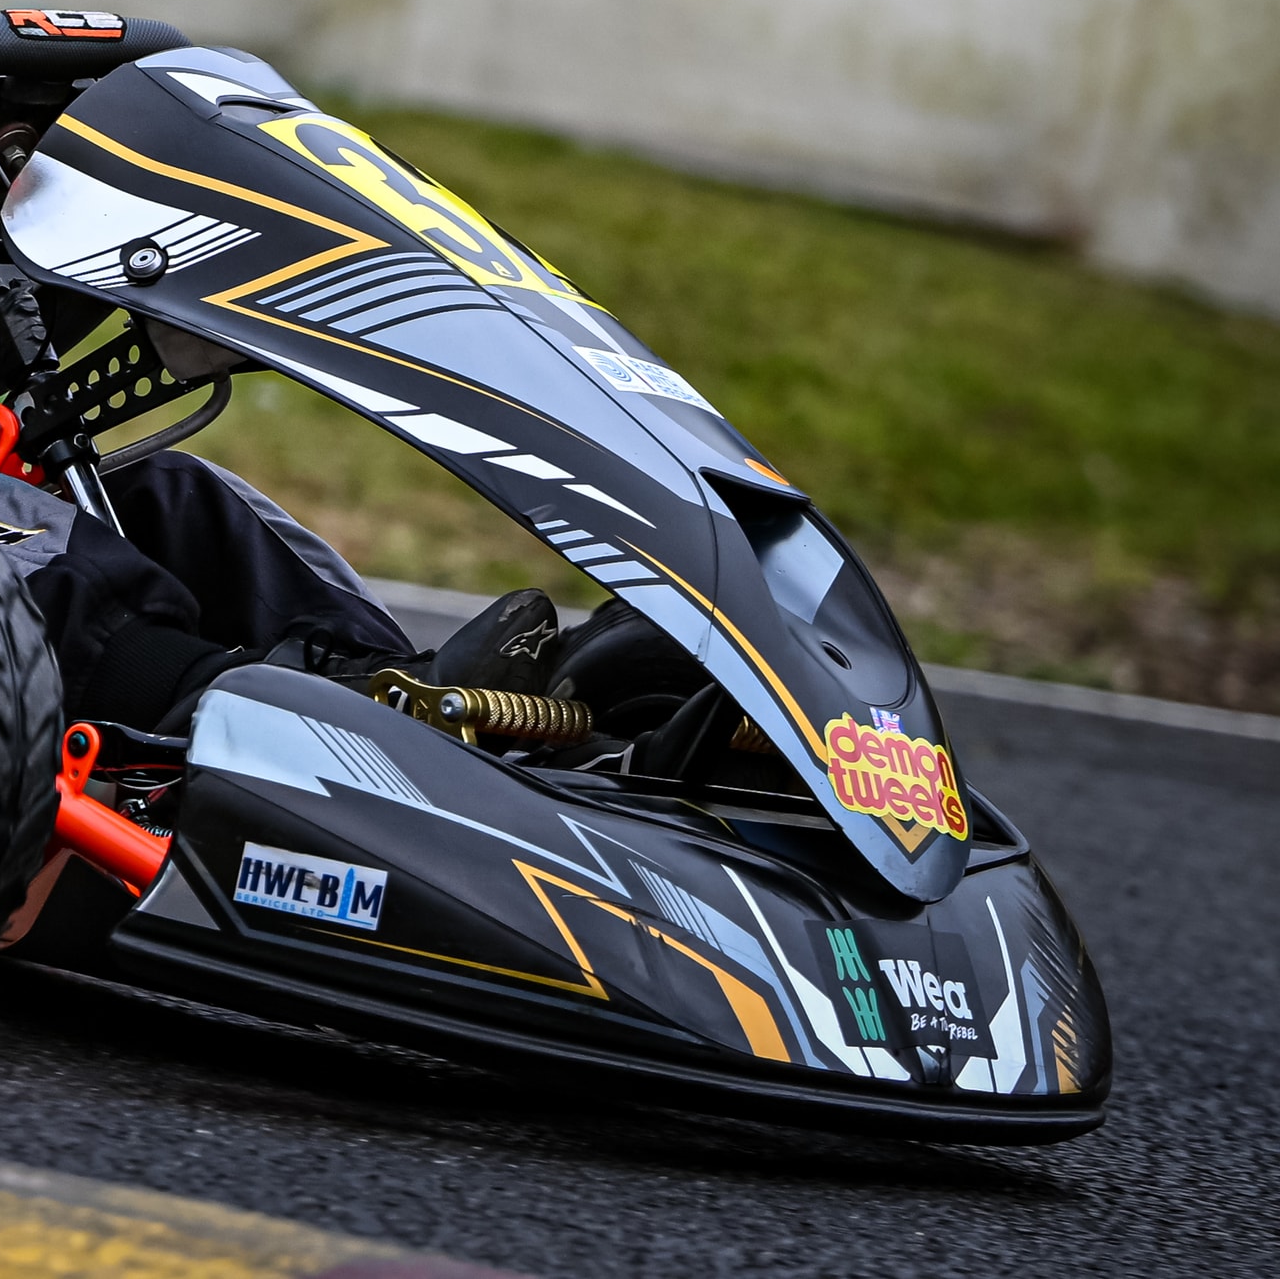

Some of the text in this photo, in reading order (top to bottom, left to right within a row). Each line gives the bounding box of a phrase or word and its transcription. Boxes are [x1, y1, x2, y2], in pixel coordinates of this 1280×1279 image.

[829, 718, 955, 792] demon
[828, 757, 966, 834] tweeks
[235, 891, 325, 918] SERVICES LTD
[238, 856, 315, 904] HWE
[878, 959, 973, 1020] Wea
[910, 1013, 927, 1031] BE
[930, 1016, 938, 1028] A
[948, 1023, 978, 1040] REBEL
